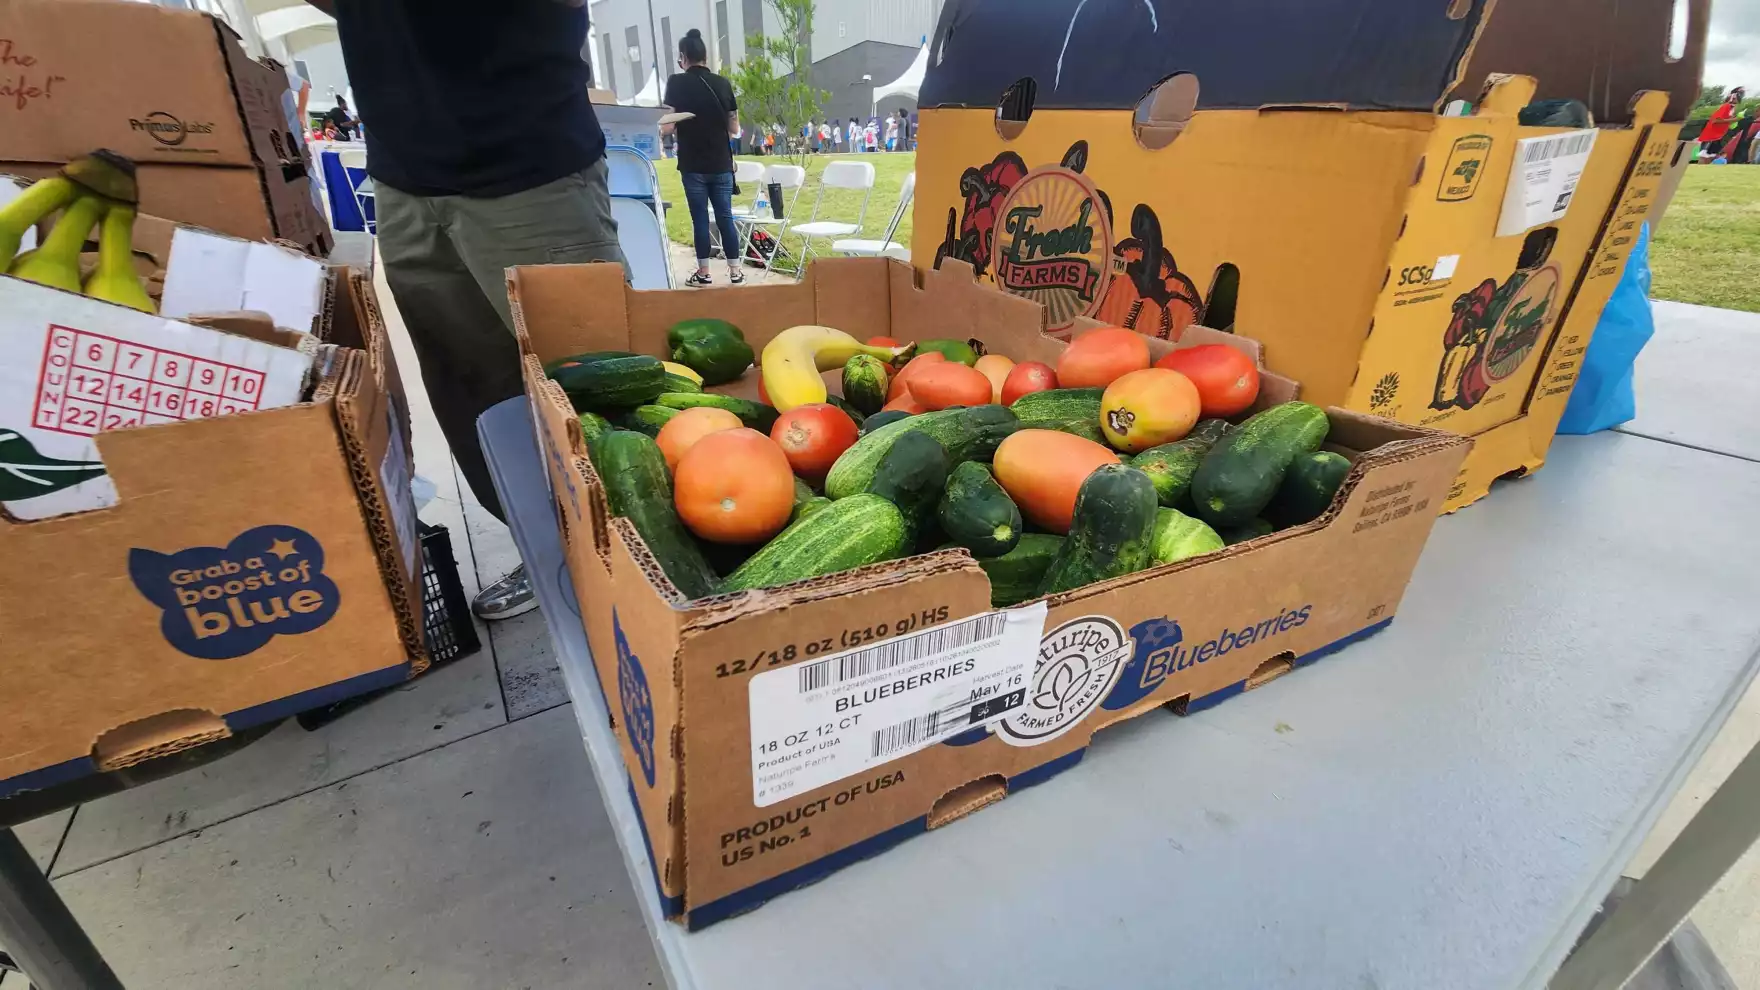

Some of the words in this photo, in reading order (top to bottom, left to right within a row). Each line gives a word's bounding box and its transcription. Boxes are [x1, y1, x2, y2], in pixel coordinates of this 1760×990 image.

[1005, 197, 1093, 262] Fresh
[1011, 264, 1081, 286] FARMS
[88, 344, 103, 361] 6
[127, 352, 143, 369] 7
[164, 361, 178, 378] 8
[201, 368, 215, 385] 9
[231, 375, 256, 394] 10
[74, 375, 104, 396] 12
[115, 383, 143, 404] 14
[151, 391, 180, 411] 16
[188, 398, 213, 417] 18
[65, 407, 98, 428] 22
[169, 559, 241, 585] Grab
[244, 556, 265, 569] a
[175, 570, 276, 606] boost
[278, 559, 311, 583] of
[185, 589, 324, 640] blue
[716, 645, 797, 679] 12/18
[805, 637, 833, 656] oz
[841, 622, 888, 648] (510
[895, 613, 916, 636] g)
[921, 605, 949, 626] HS
[1033, 625, 1110, 678] aturipe
[1098, 650, 1120, 668] 1917
[1143, 604, 1312, 686] Blueberries
[835, 657, 976, 713] BLUEBERRIES
[969, 683, 1001, 702] May
[1007, 673, 1022, 688] 16
[1004, 693, 1020, 709] 12
[1017, 712, 1064, 730] FARMED
[1069, 673, 1106, 714] FRESH
[758, 750, 802, 770] Product
[805, 744, 818, 755] of
[819, 737, 841, 750] USA
[759, 740, 778, 754] 18
[784, 730, 809, 747] OZ
[816, 723, 833, 737] 12
[839, 713, 862, 730] CT
[758, 765, 802, 784] Naturipe
[720, 797, 831, 849] PRODUCT
[834, 785, 863, 807] OF
[865, 769, 906, 794] USA
[721, 846, 754, 867] US
[759, 832, 796, 854] No.
[800, 826, 812, 840] 1
